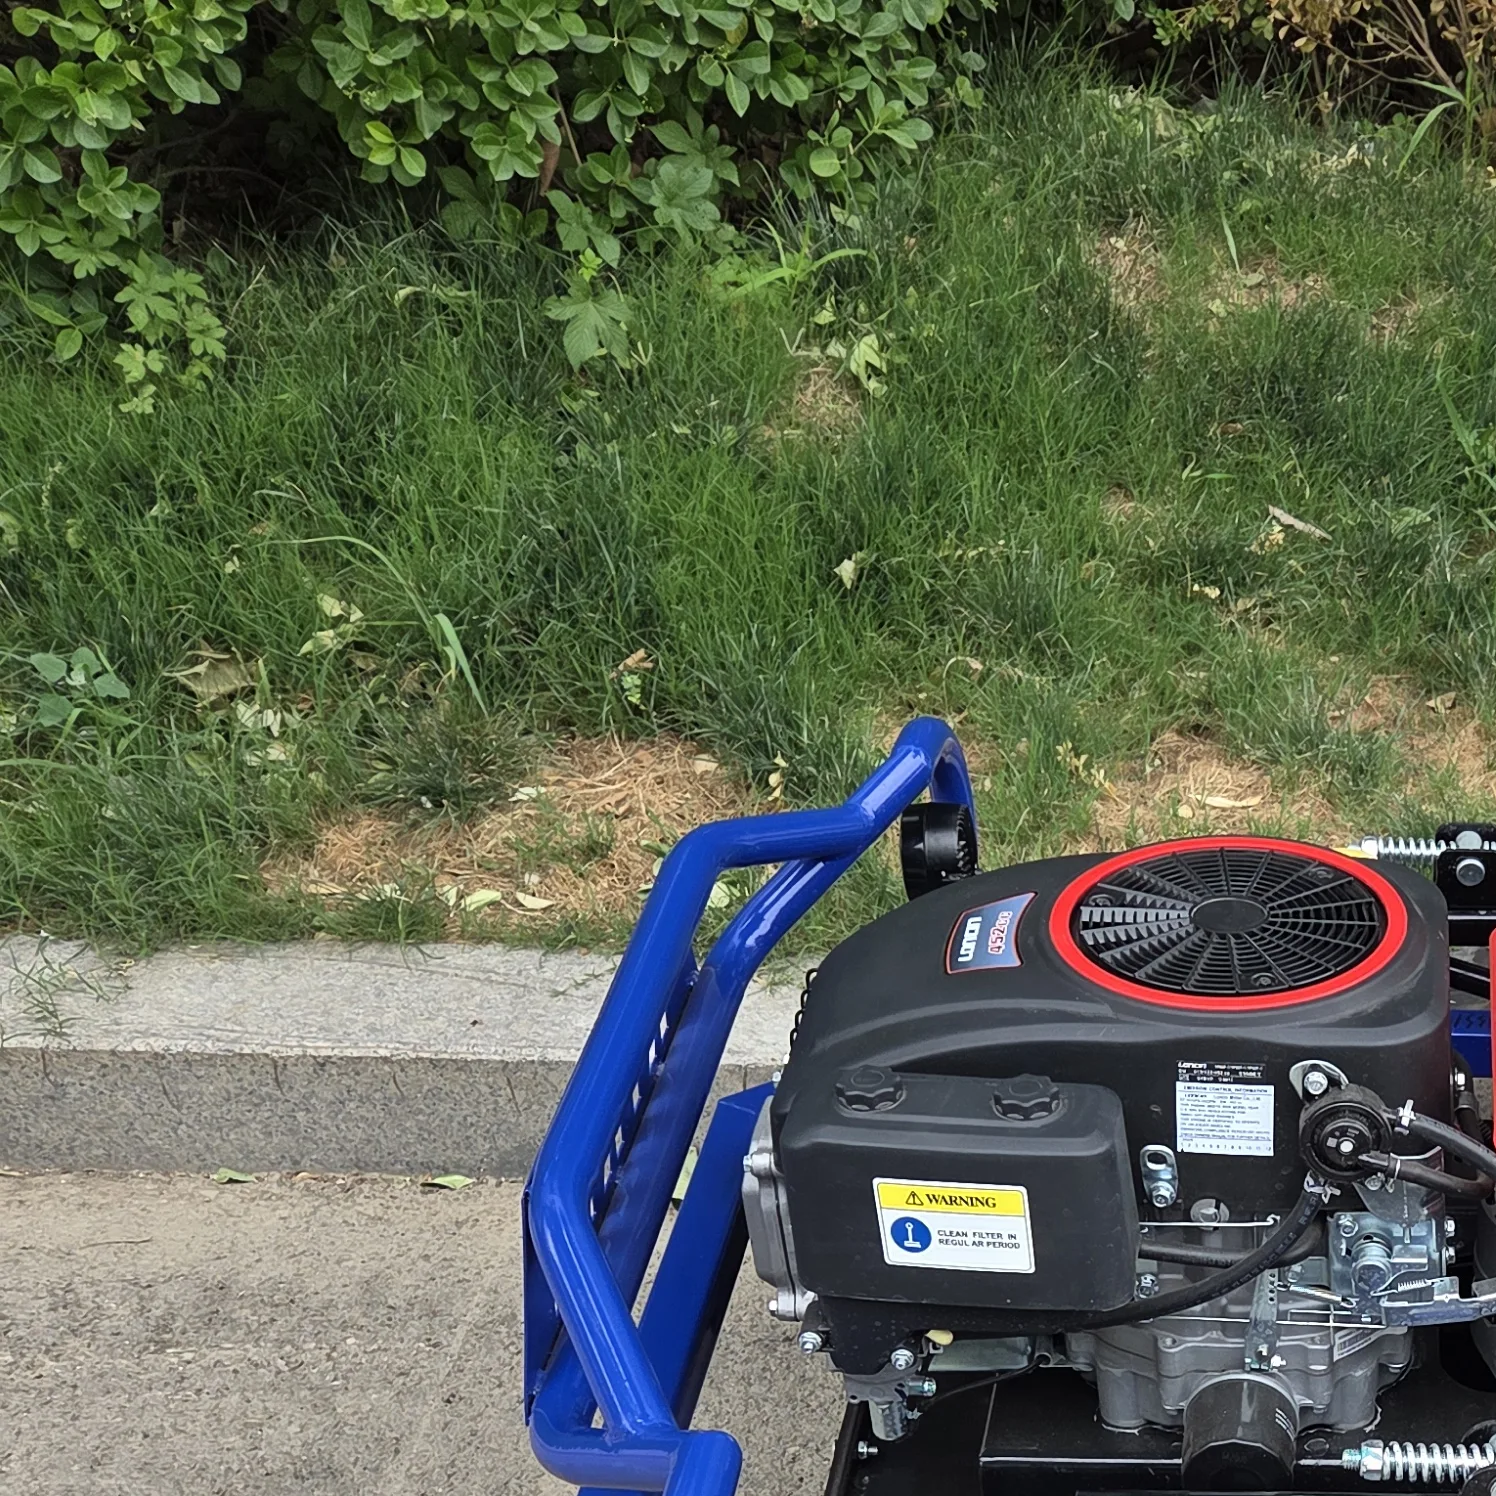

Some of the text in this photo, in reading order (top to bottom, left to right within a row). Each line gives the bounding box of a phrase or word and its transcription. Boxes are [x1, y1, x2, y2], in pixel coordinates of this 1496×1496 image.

[925, 1194, 996, 1208] WARNING
[937, 1229, 968, 1238] CLEAN
[973, 1231, 1003, 1240] FILTER
[987, 1240, 1020, 1249] PERIOD
